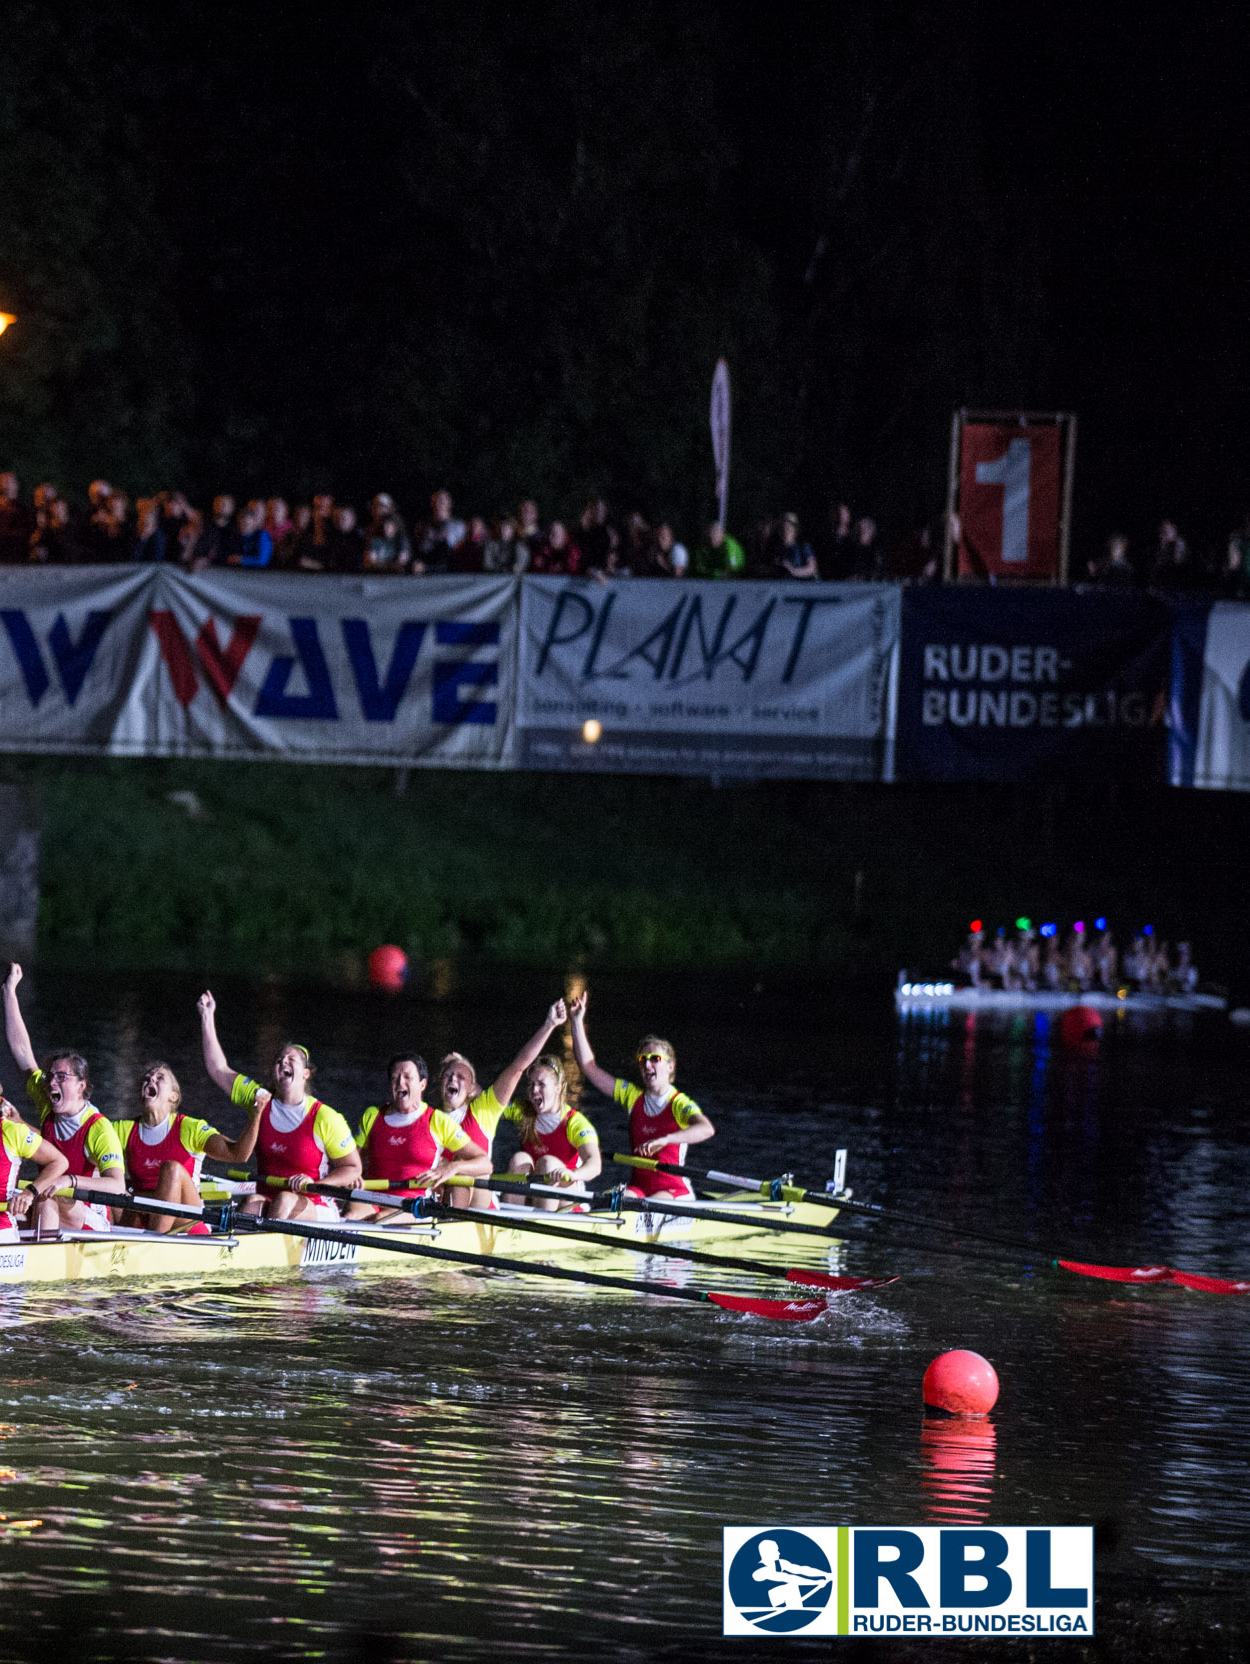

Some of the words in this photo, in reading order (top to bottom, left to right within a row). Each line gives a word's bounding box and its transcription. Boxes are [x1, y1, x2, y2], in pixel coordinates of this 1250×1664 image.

[975, 437, 1031, 562] 1
[149, 610, 498, 724] WAVE
[536, 590, 842, 681] PLANAT
[922, 642, 1072, 682] RUDER-
[921, 687, 1167, 728] BUNDESLIGA
